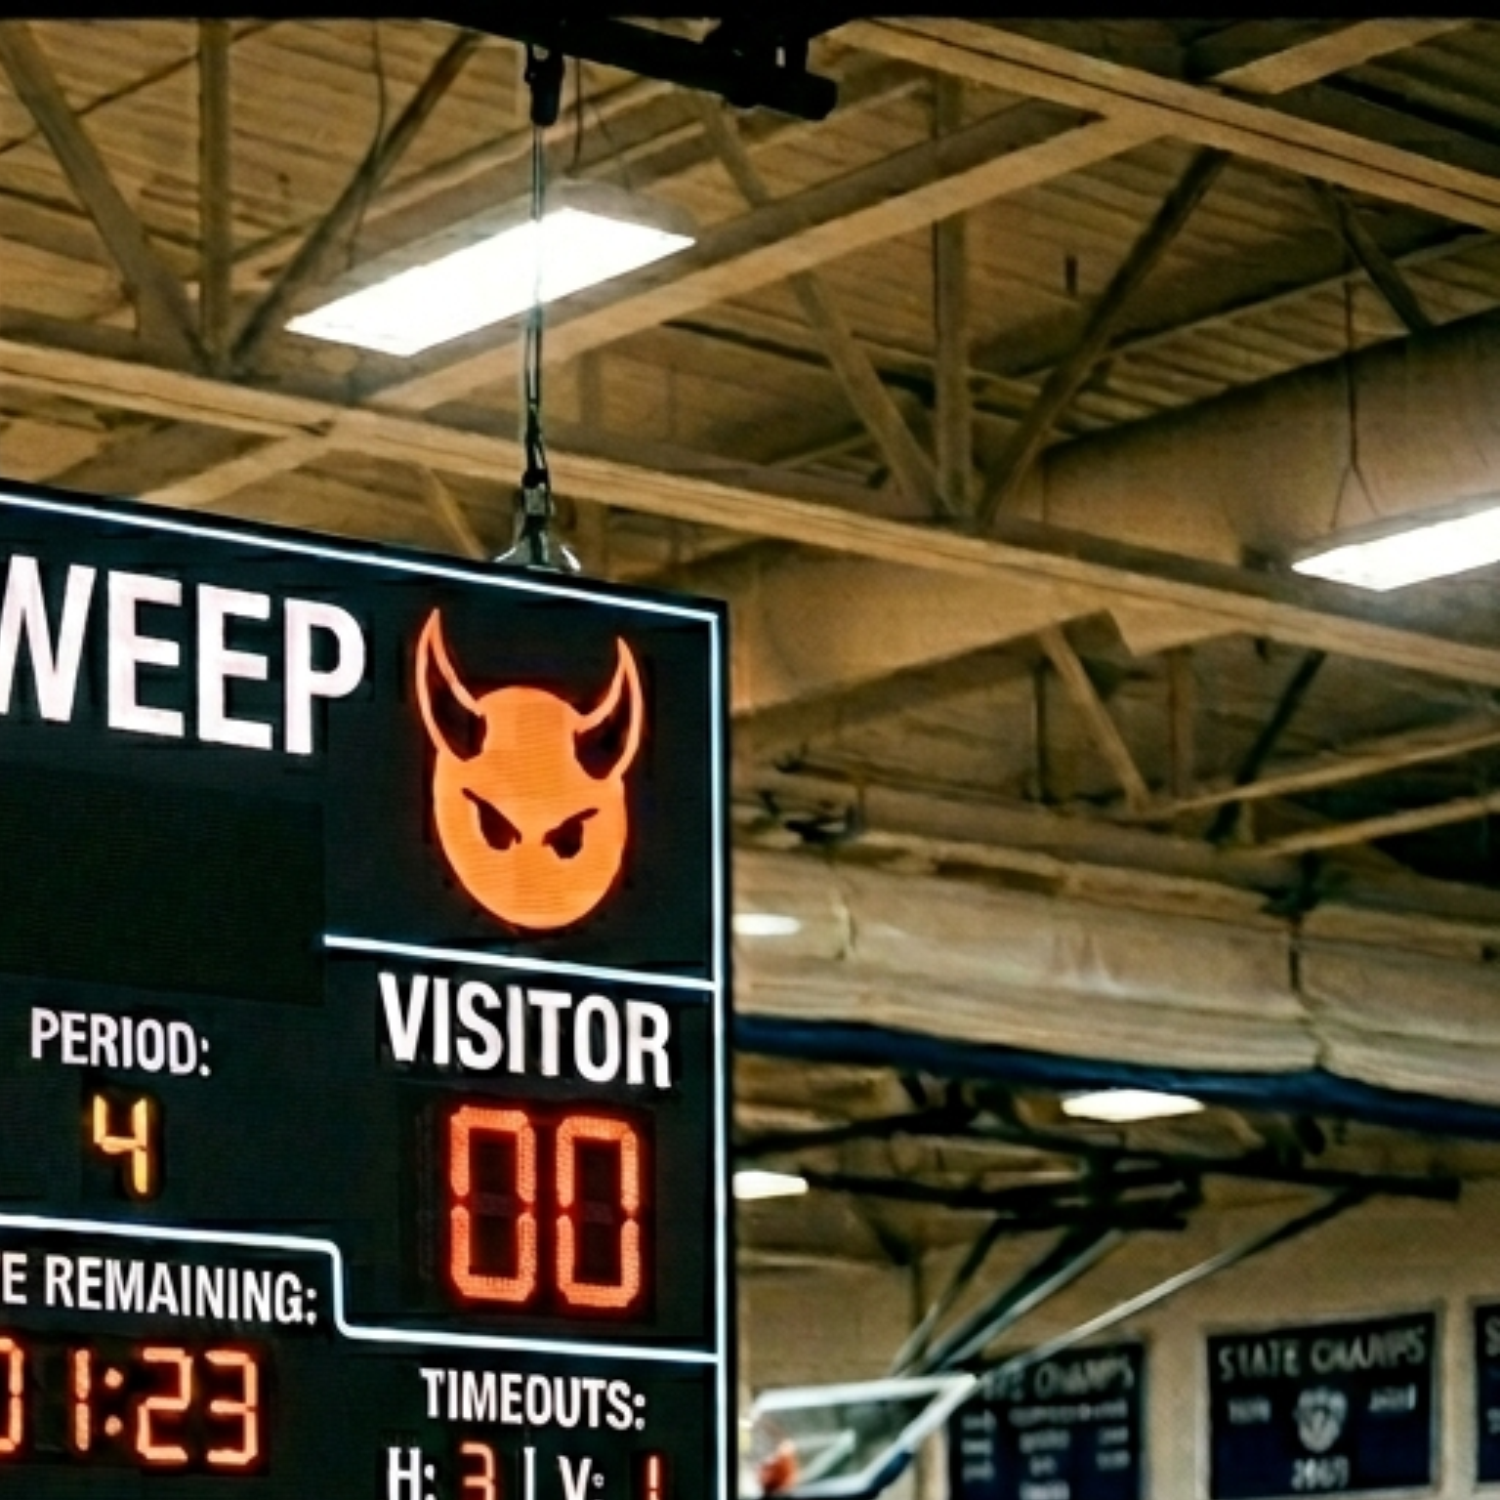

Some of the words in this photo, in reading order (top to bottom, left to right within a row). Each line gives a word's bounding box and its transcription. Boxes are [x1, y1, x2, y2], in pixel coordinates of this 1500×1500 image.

[31, 1007, 211, 1077] PERIOD:
[379, 972, 673, 1089] VISITOR
[92, 1095, 149, 1194] 4
[449, 1105, 640, 1308] 00
[45, 1257, 319, 1325] REMAINING:
[420, 1367, 646, 1431] TIMEOUTS:
